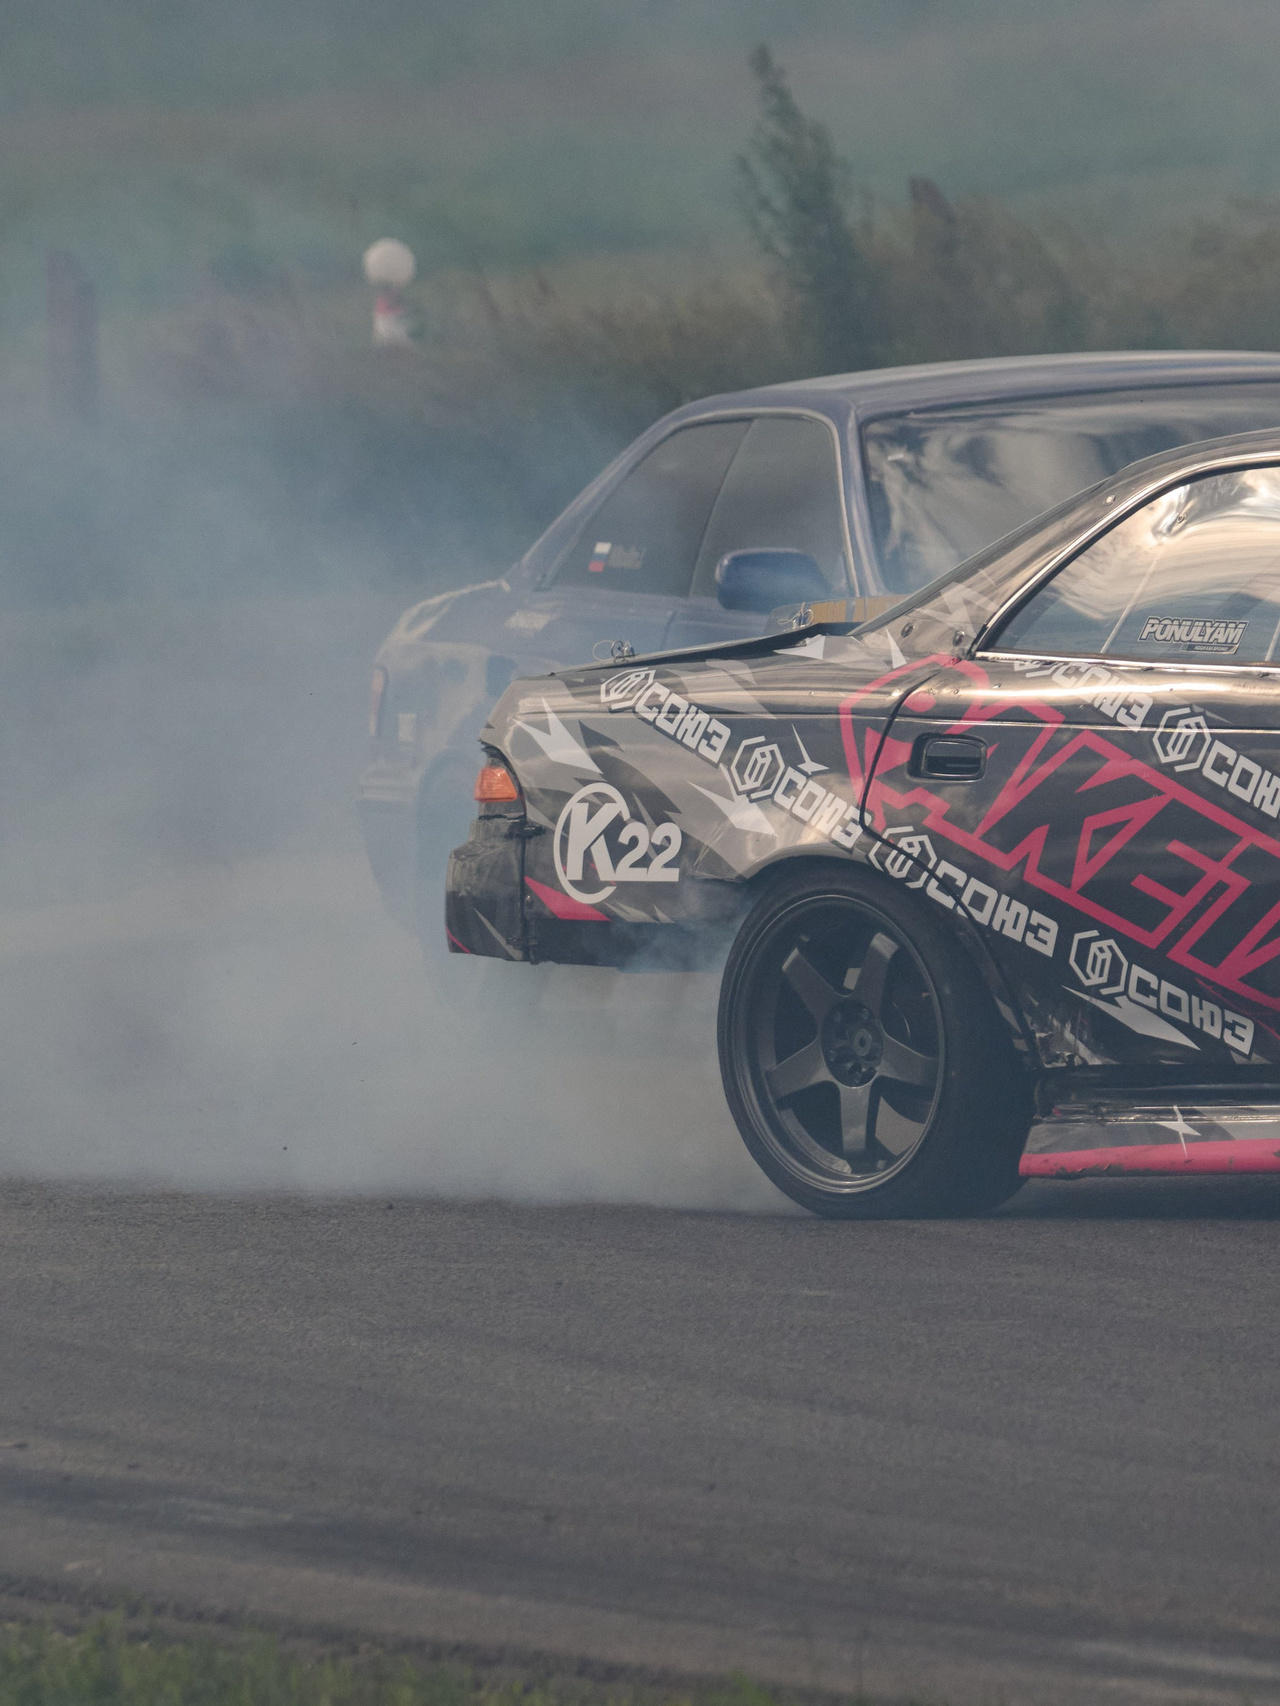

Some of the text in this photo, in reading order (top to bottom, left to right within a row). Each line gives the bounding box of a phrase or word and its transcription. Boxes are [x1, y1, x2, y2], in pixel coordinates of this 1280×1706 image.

[1139, 617, 1248, 645] PONULYAM
[635, 682, 731, 764] СОЮЗ
[1052, 661, 1153, 732] СОЮЗ
[558, 792, 682, 893] K22
[774, 766, 872, 850] СОЮЗ
[926, 859, 1059, 958] СОЮЗ
[1128, 964, 1255, 1055] СОЮЗ
